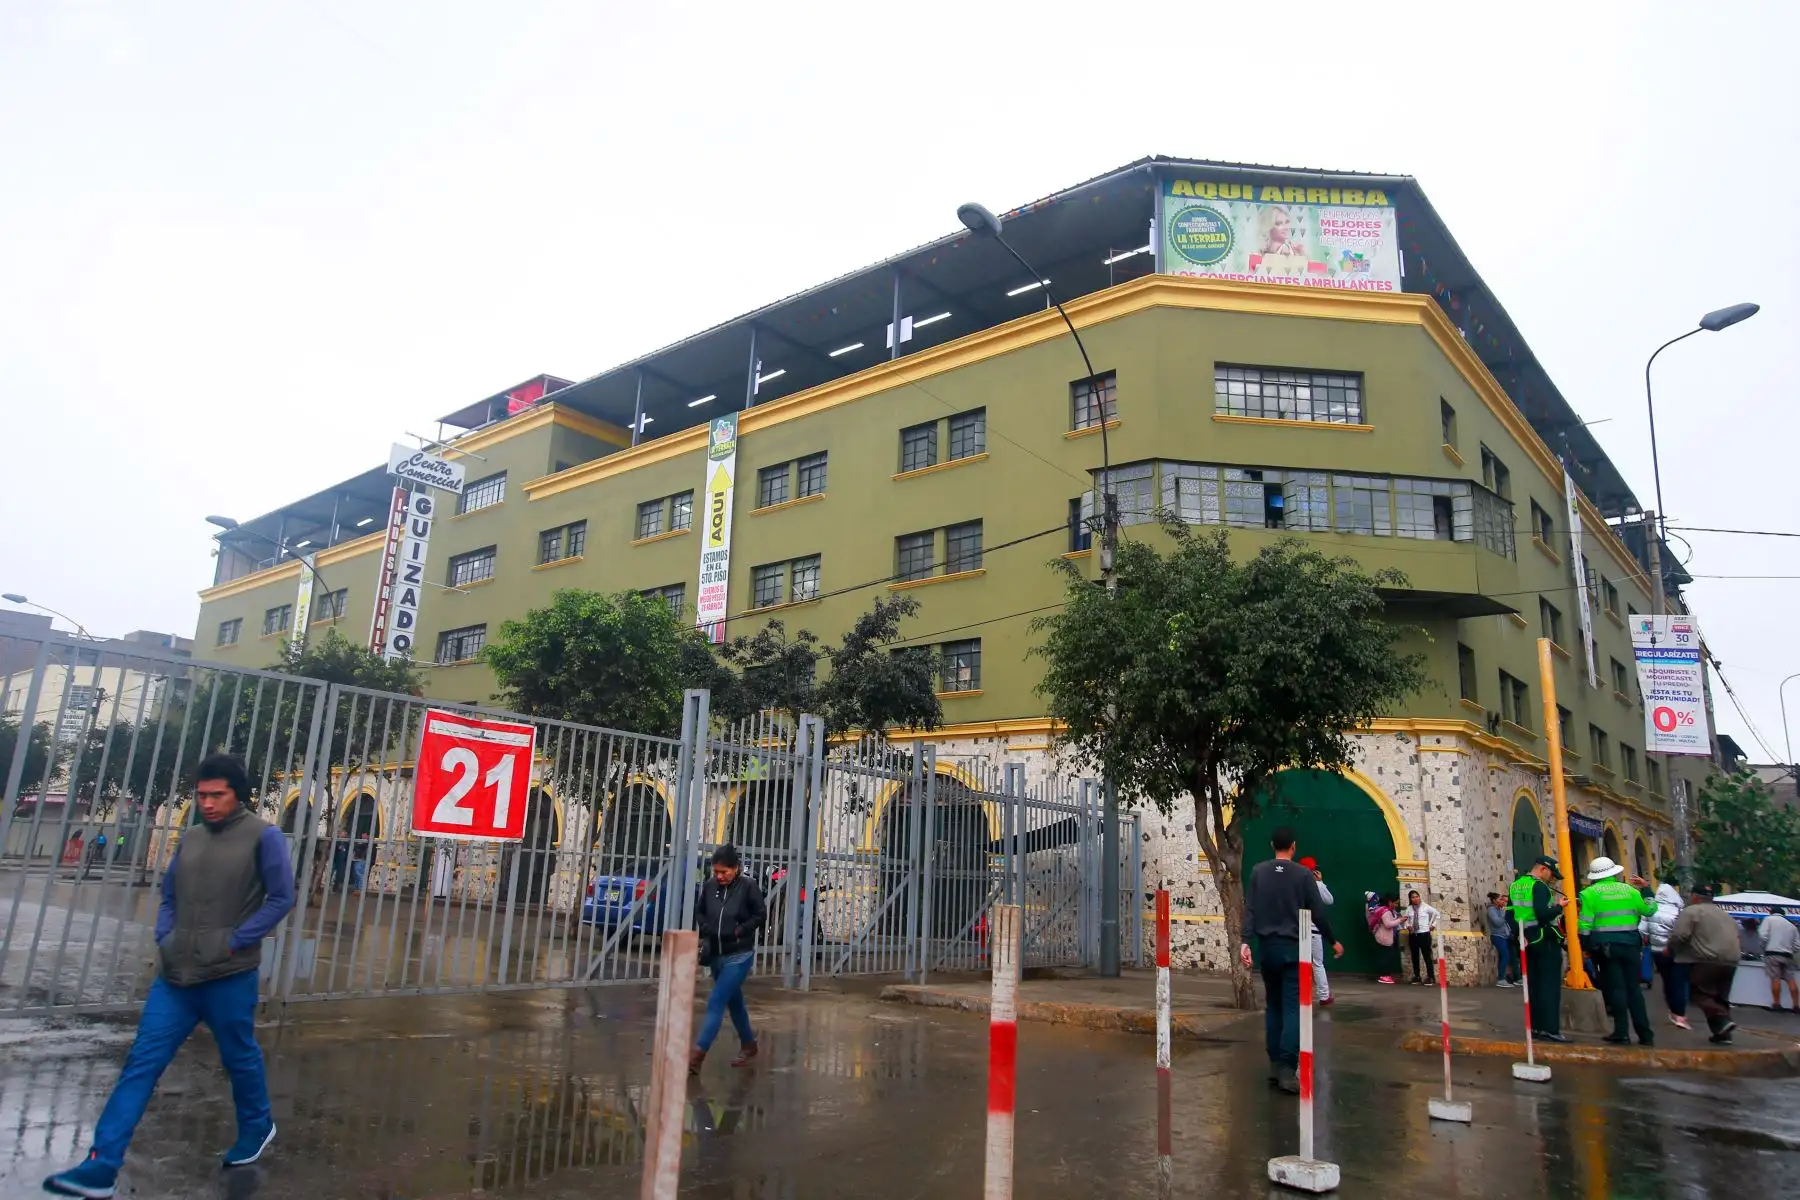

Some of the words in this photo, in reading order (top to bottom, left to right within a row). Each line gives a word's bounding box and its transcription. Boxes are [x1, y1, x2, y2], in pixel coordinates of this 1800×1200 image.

[1172, 179, 1253, 200] AQUI
[1259, 185, 1389, 206] ARRIBA
[1320, 219, 1382, 229] MEJORES
[1189, 233, 1227, 243] TERRAZA
[1323, 228, 1380, 238] PRECIOS
[1303, 277, 1393, 291] AMBULANTES
[410, 452, 453, 477] Centro
[395, 460, 462, 490] Comercial
[712, 491, 724, 542] AQUI
[704, 549, 728, 564] ESTAMOS
[715, 562, 722, 570] EL
[373, 498, 404, 656] INDUSTRIALE
[393, 498, 433, 652] GUIZADO
[713, 570, 727, 583] PISO
[1676, 634, 1689, 643] 30
[431, 746, 516, 829] 21
